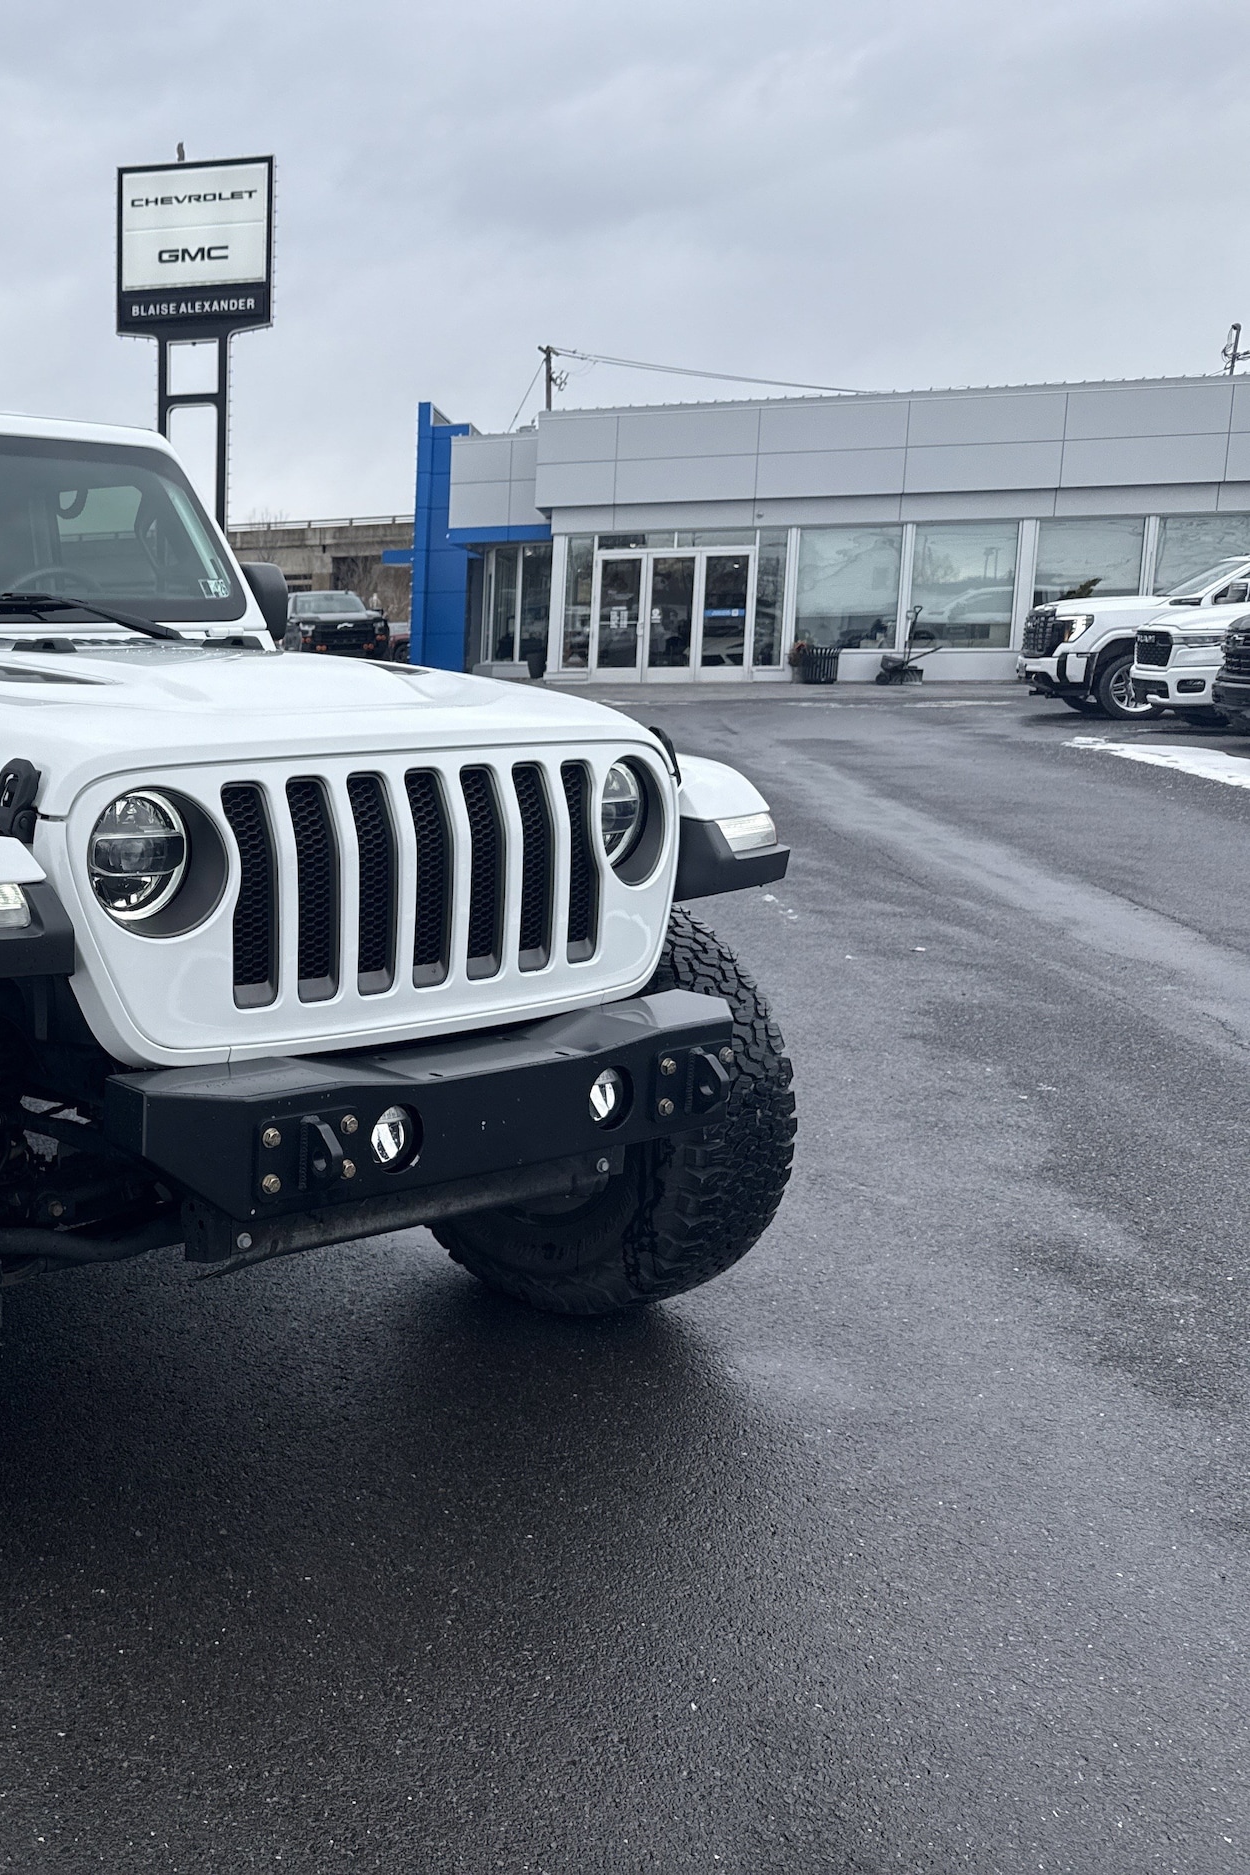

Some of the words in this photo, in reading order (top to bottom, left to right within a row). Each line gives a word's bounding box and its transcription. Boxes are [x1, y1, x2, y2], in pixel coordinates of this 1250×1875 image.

[131, 190, 258, 208] CHEVROLET
[158, 245, 229, 264] GMC
[131, 303, 177, 317] BLAISE
[179, 298, 255, 314] ALEXANDER
